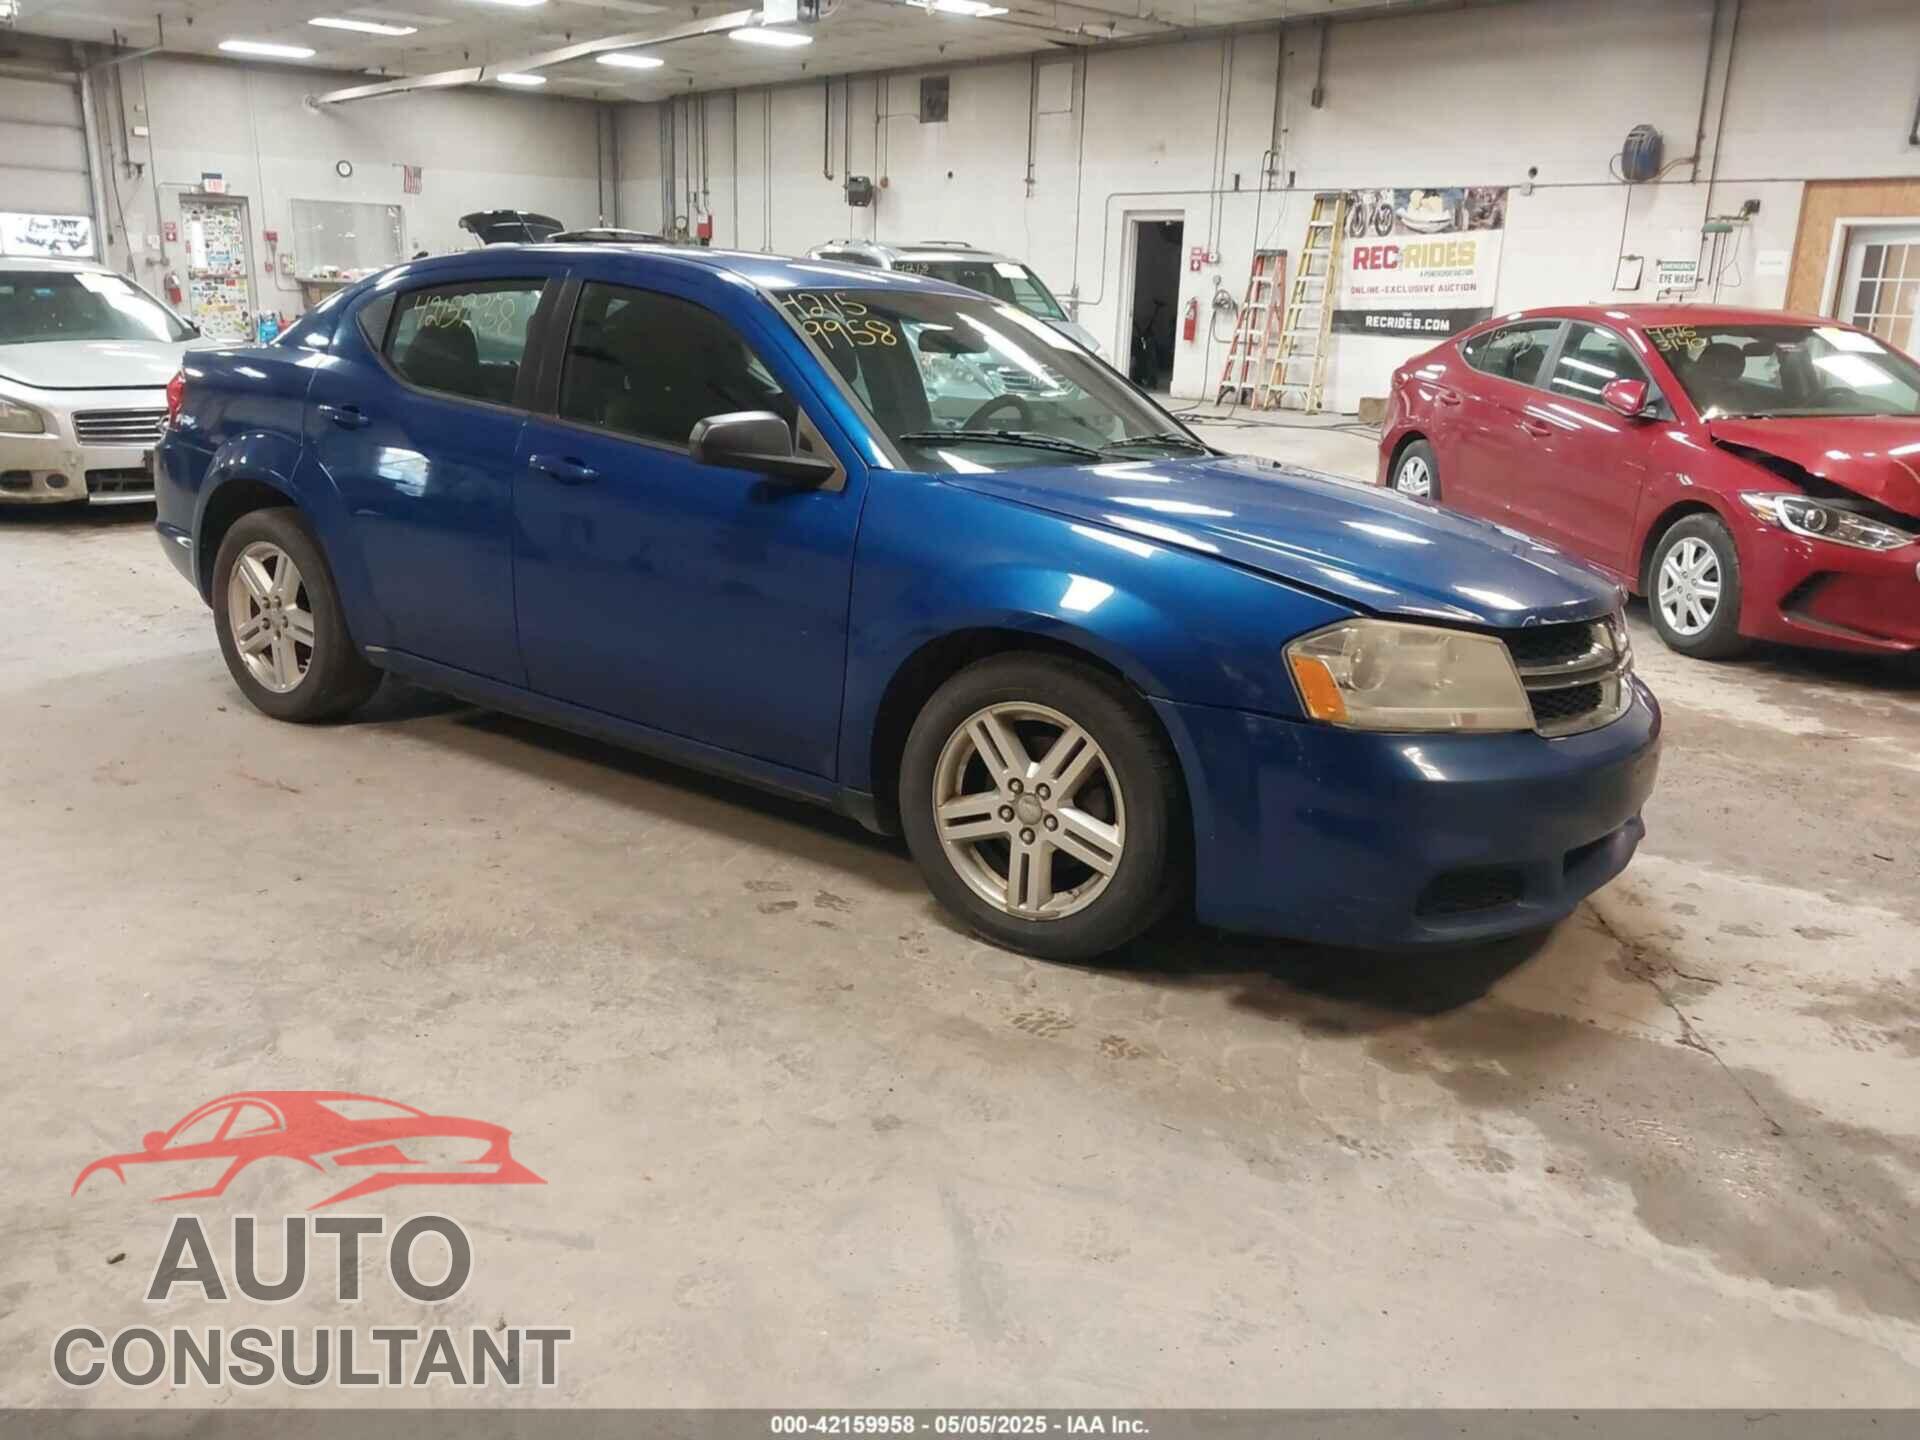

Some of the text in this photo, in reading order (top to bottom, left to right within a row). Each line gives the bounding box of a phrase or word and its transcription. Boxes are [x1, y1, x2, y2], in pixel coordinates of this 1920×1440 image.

[1352, 241, 1476, 270] REC RIDES
[1351, 282, 1477, 295] ONLINE-EXCLUSIVE AUCTION
[1659, 273, 1695, 284] EYE WASH
[782, 292, 868, 319] 4215
[1365, 315, 1451, 331] RECRIDES.COM
[802, 319, 898, 349] 9958
